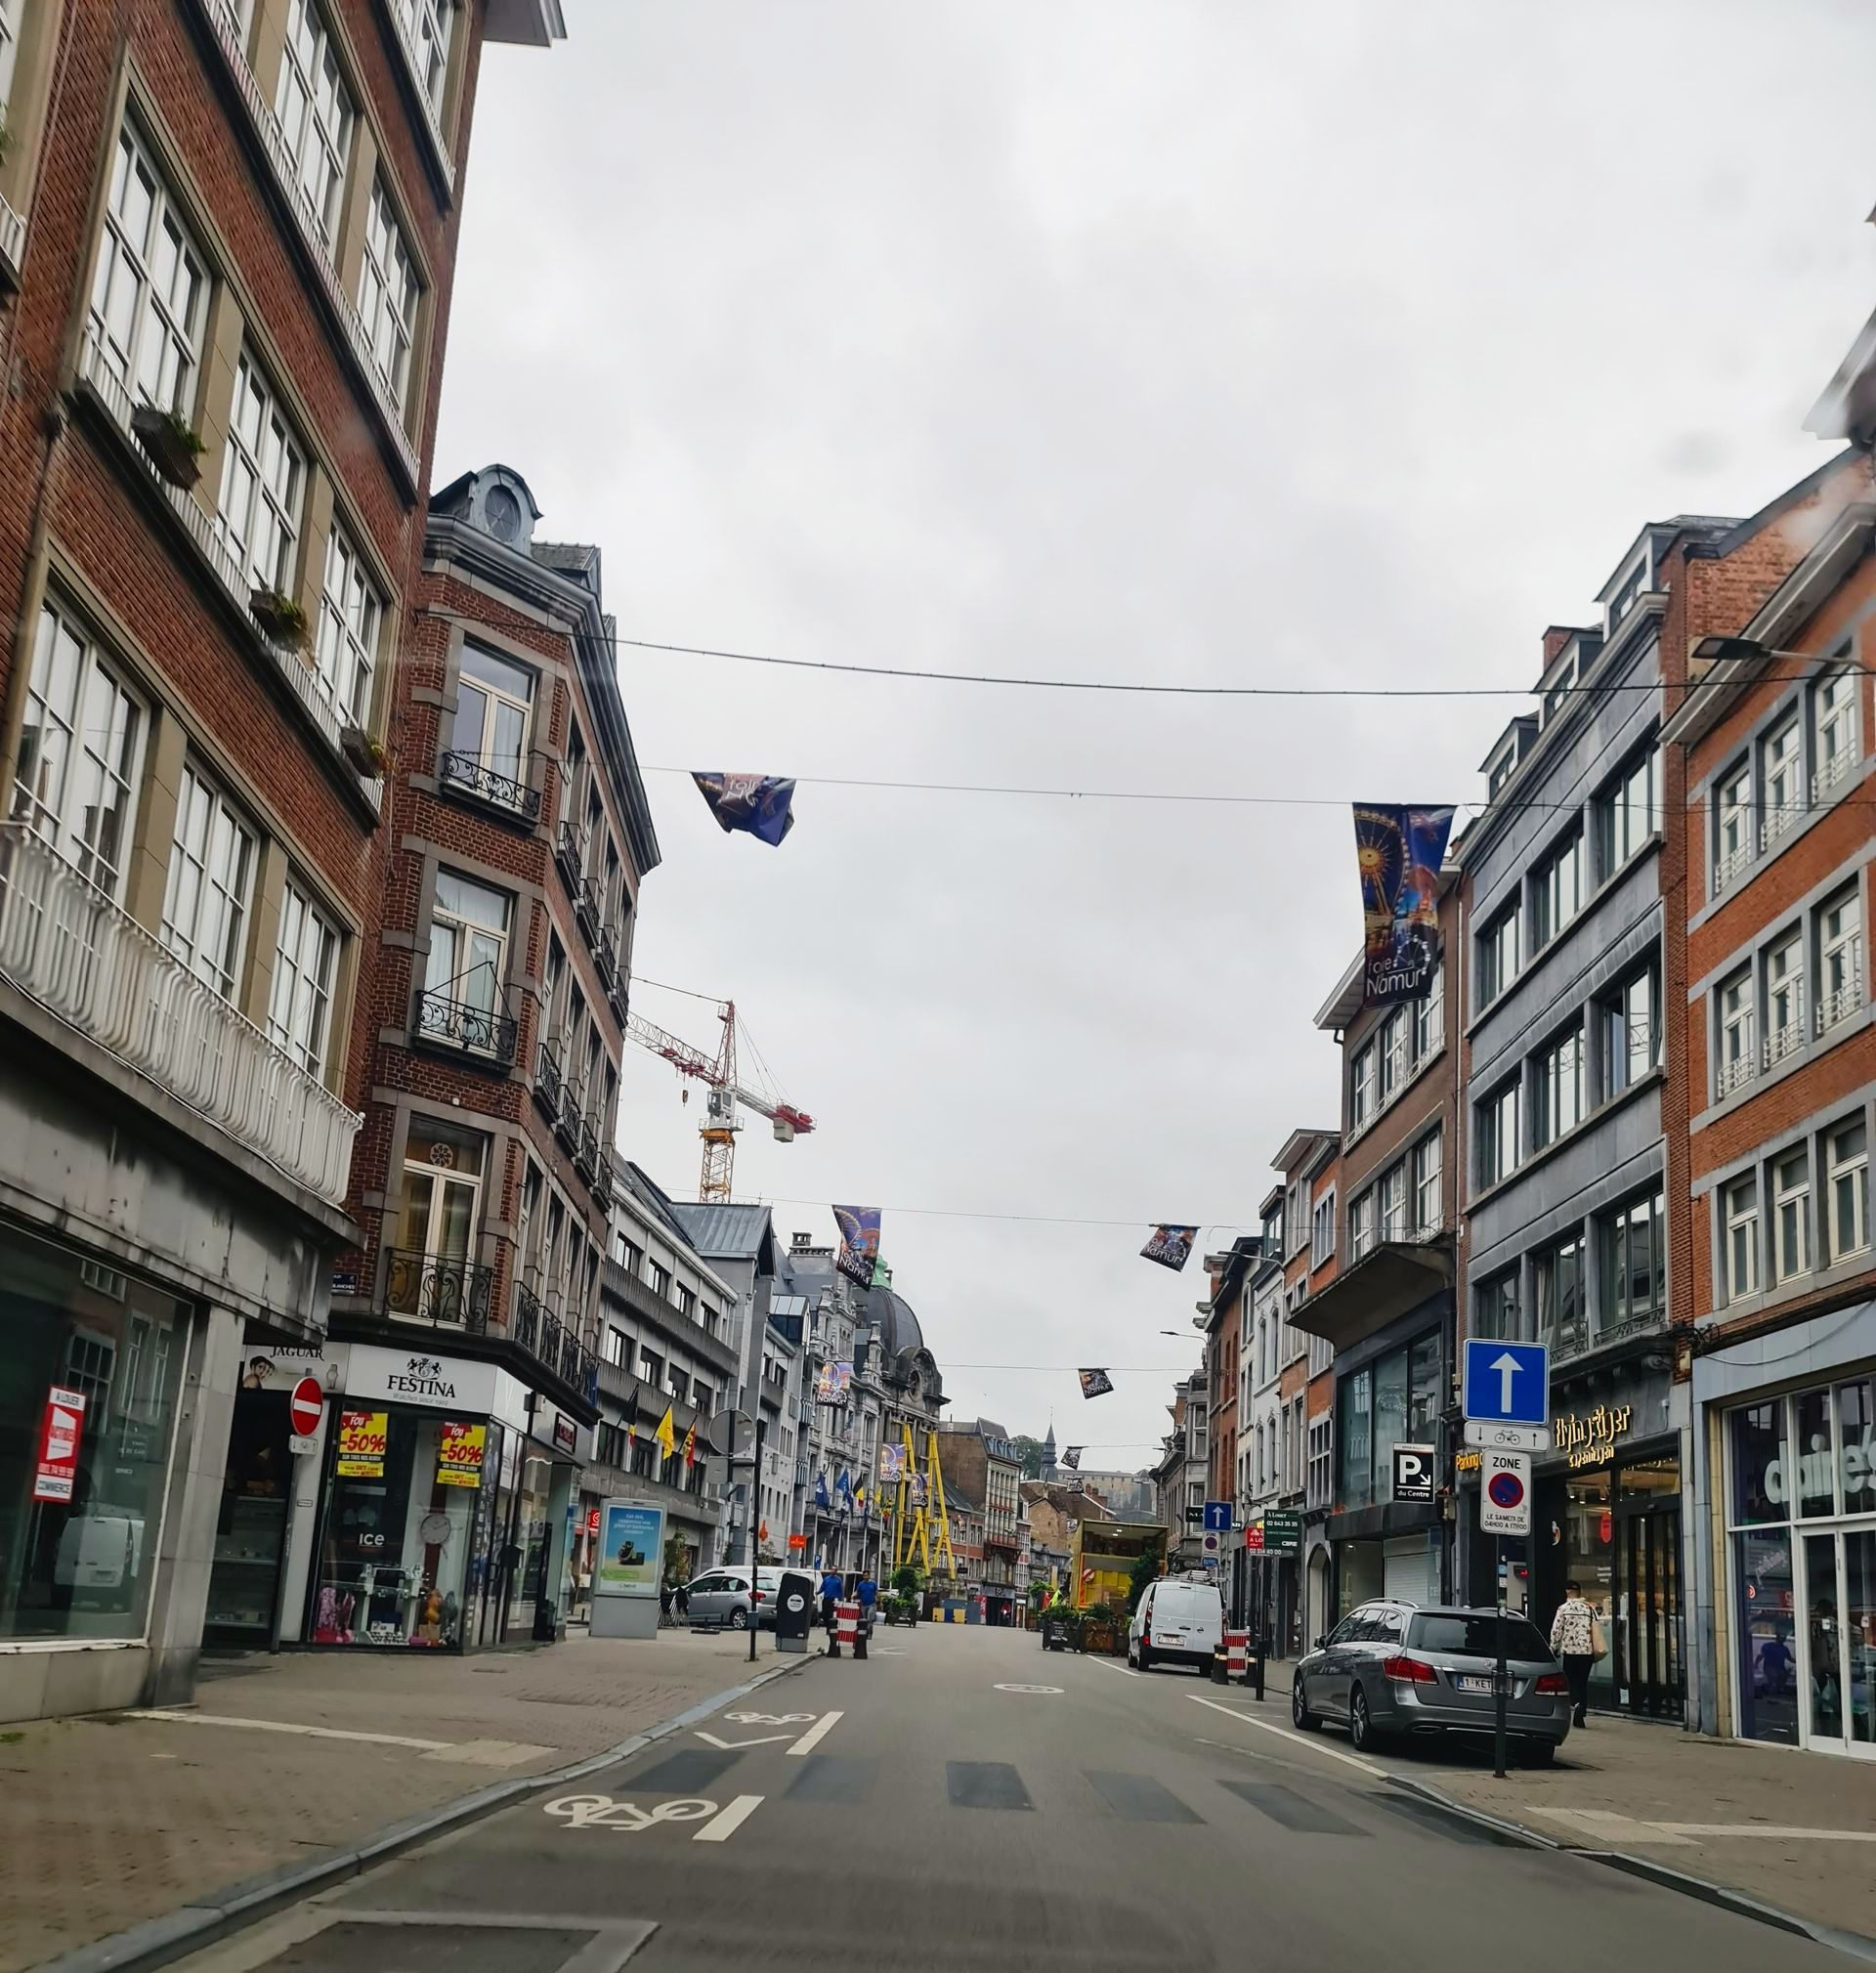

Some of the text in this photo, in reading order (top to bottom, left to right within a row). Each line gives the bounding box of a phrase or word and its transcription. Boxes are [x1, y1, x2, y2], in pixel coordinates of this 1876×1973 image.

[1367, 968, 1423, 997] Namur
[1143, 1244, 1180, 1263] Namur
[840, 1256, 871, 1284] Namur
[270, 1346, 324, 1361] JAGUAR
[387, 1375, 455, 1398] FESTINA
[392, 1392, 418, 1401] Watches
[817, 1395, 846, 1405] Namur
[340, 1433, 386, 1453] -50%
[439, 1443, 484, 1463] -50%
[1456, 1453, 1479, 1471] Parking
[1492, 1456, 1521, 1469] ZONE
[1399, 1454, 1422, 1483] P
[1466, 1678, 1492, 1690] 1-KET
